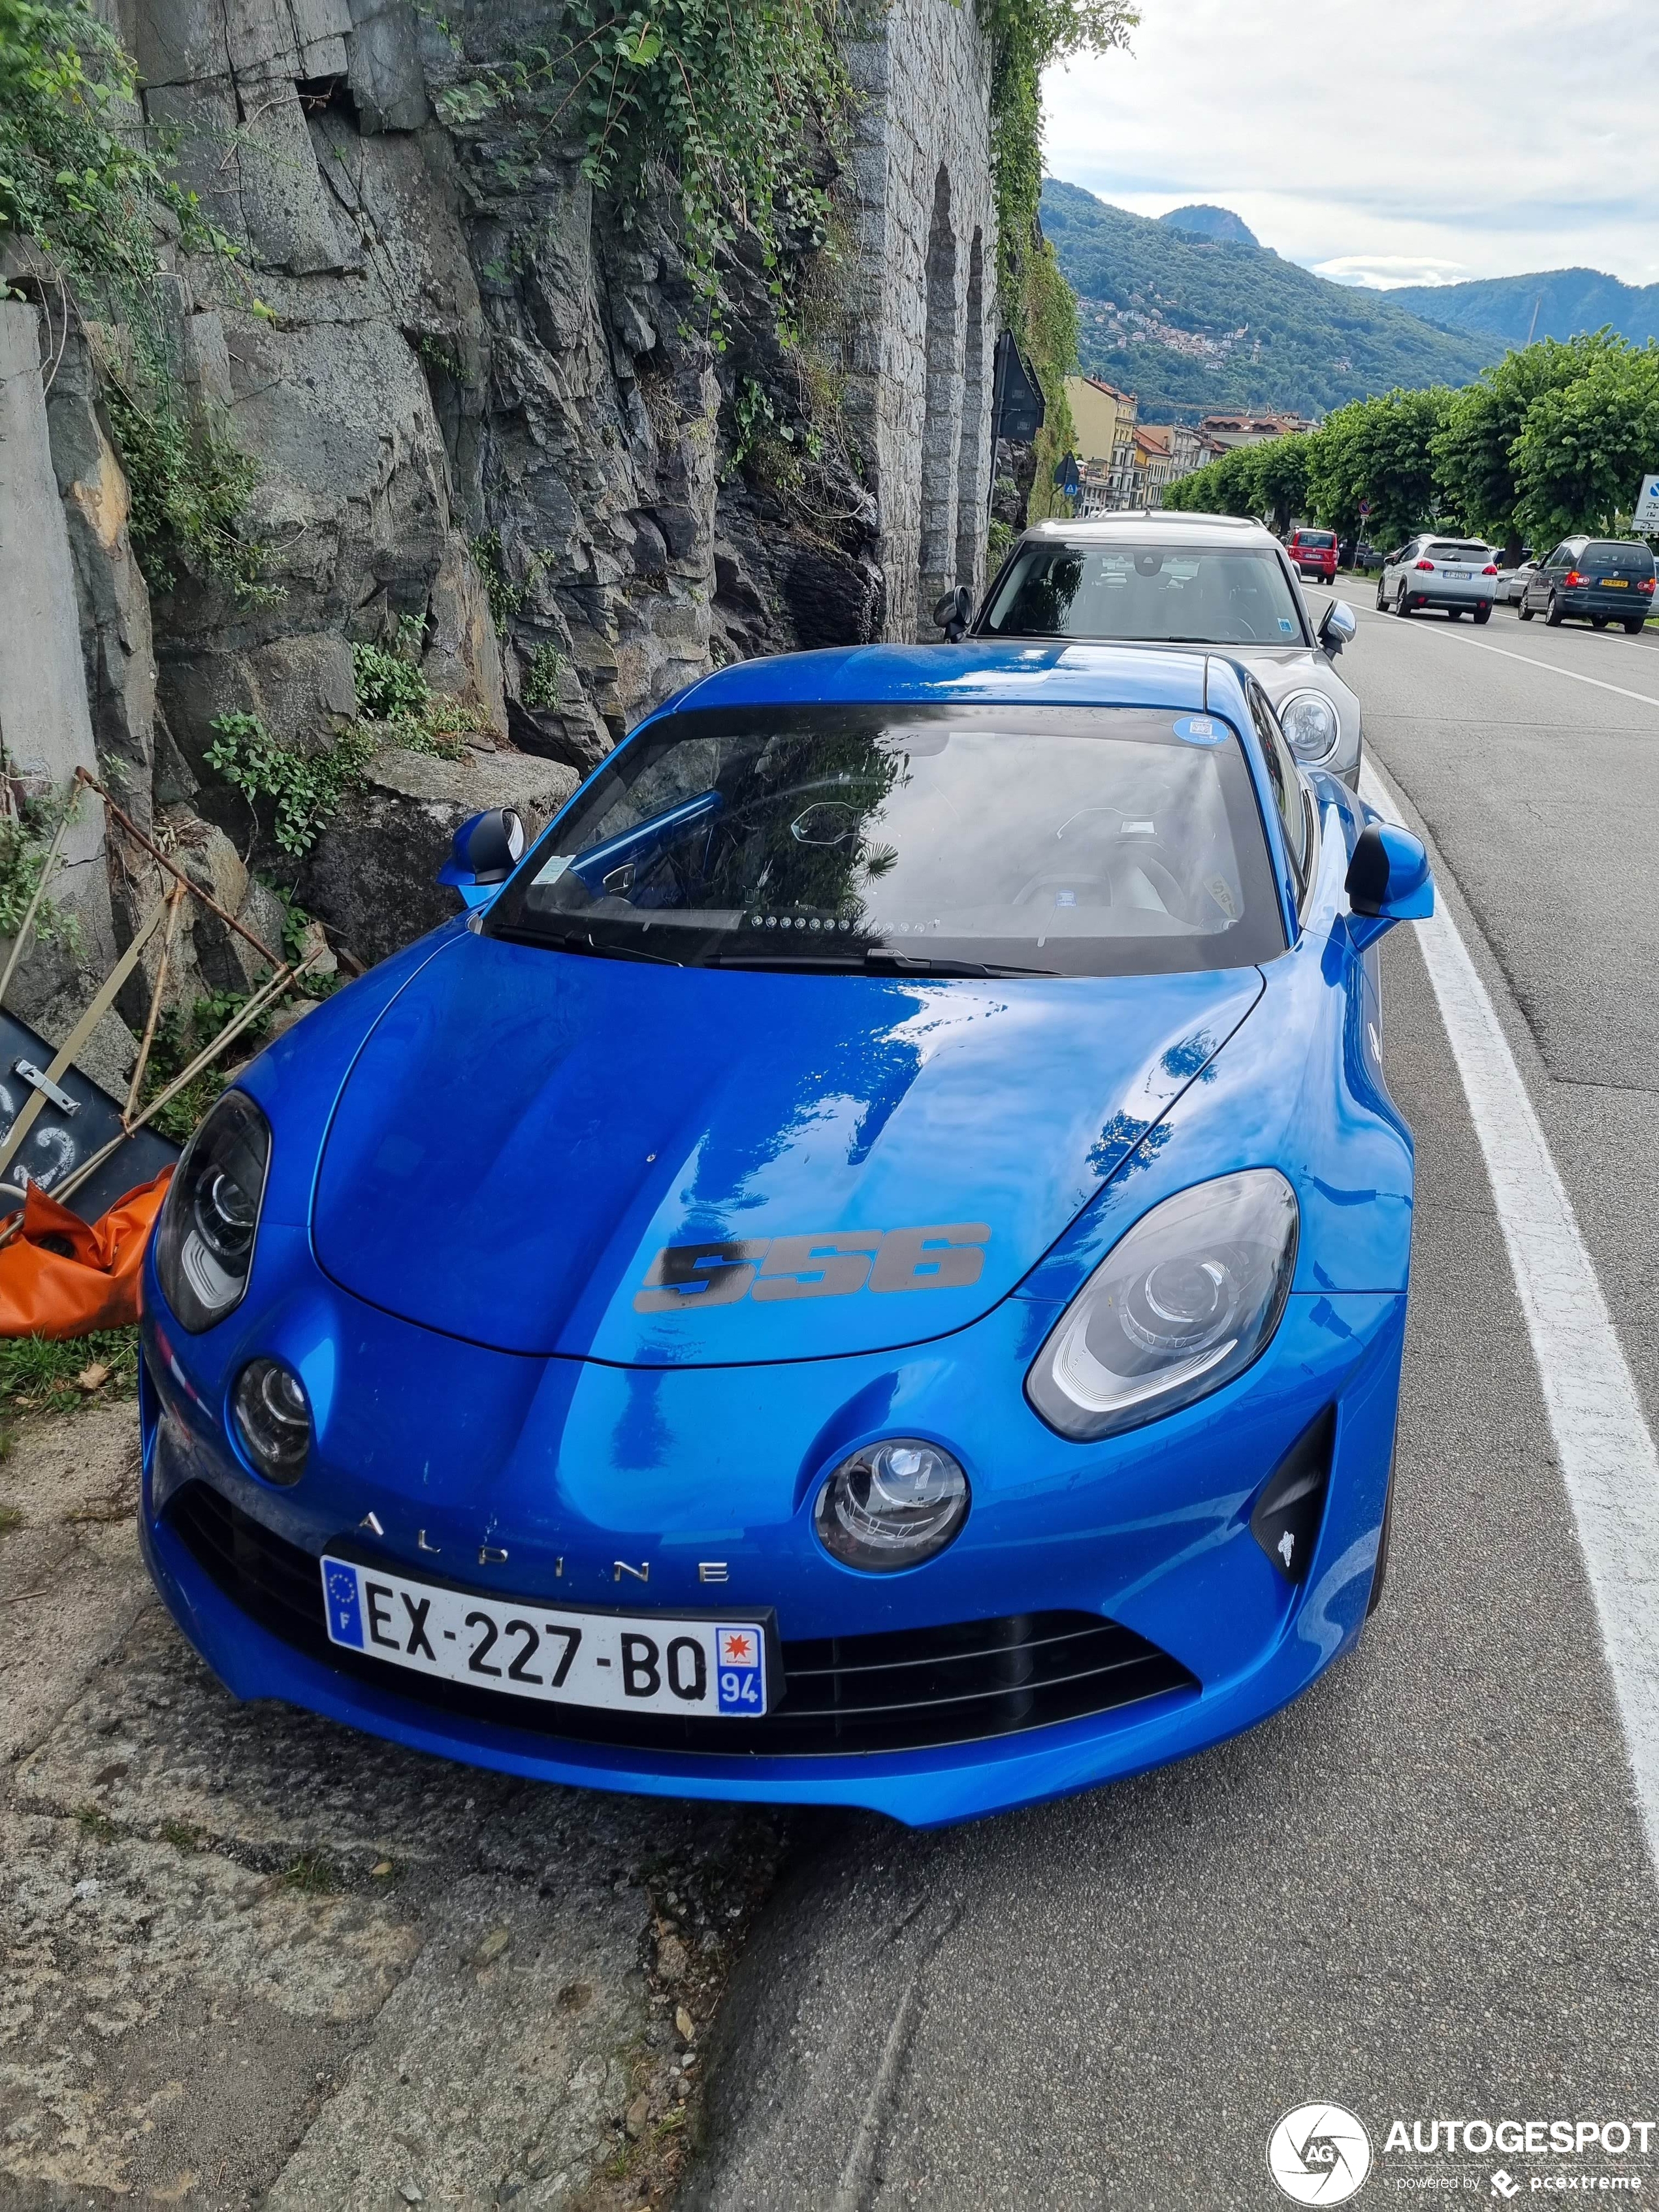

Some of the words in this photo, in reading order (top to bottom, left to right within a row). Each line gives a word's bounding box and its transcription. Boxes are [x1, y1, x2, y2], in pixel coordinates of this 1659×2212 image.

[633, 1222, 991, 1313] 556
[1070, 1349, 1087, 1369] ALPINE
[359, 1511, 730, 1583] ALPINE
[340, 1611, 351, 1630] F
[365, 1580, 707, 1702] EX-227-BQ
[721, 1672, 758, 1703] 94
